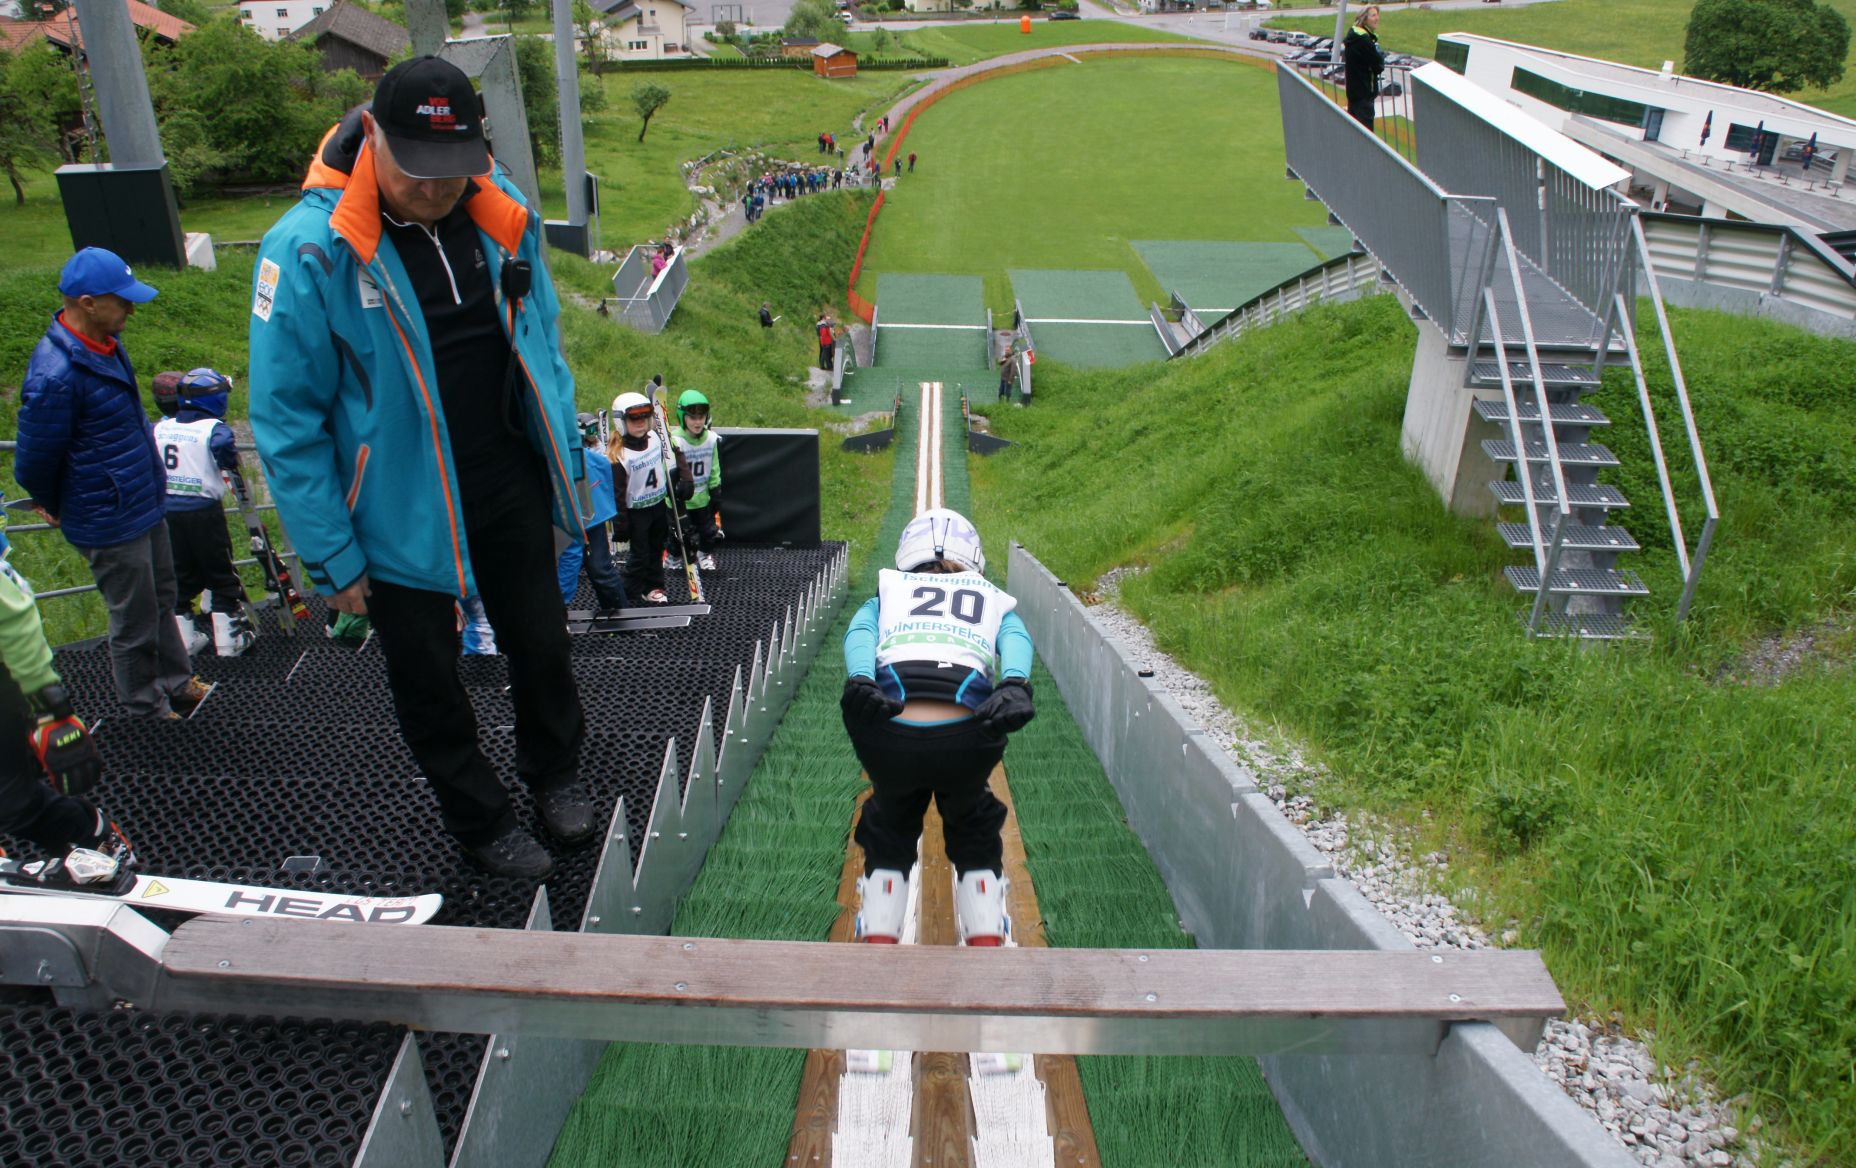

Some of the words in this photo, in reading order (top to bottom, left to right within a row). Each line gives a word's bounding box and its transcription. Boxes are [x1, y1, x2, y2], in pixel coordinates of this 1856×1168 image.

[416, 105, 450, 115] ADLER
[164, 444, 179, 470] 6
[645, 467, 658, 489] 4
[909, 586, 986, 625] 20
[224, 891, 416, 923] HEAD
